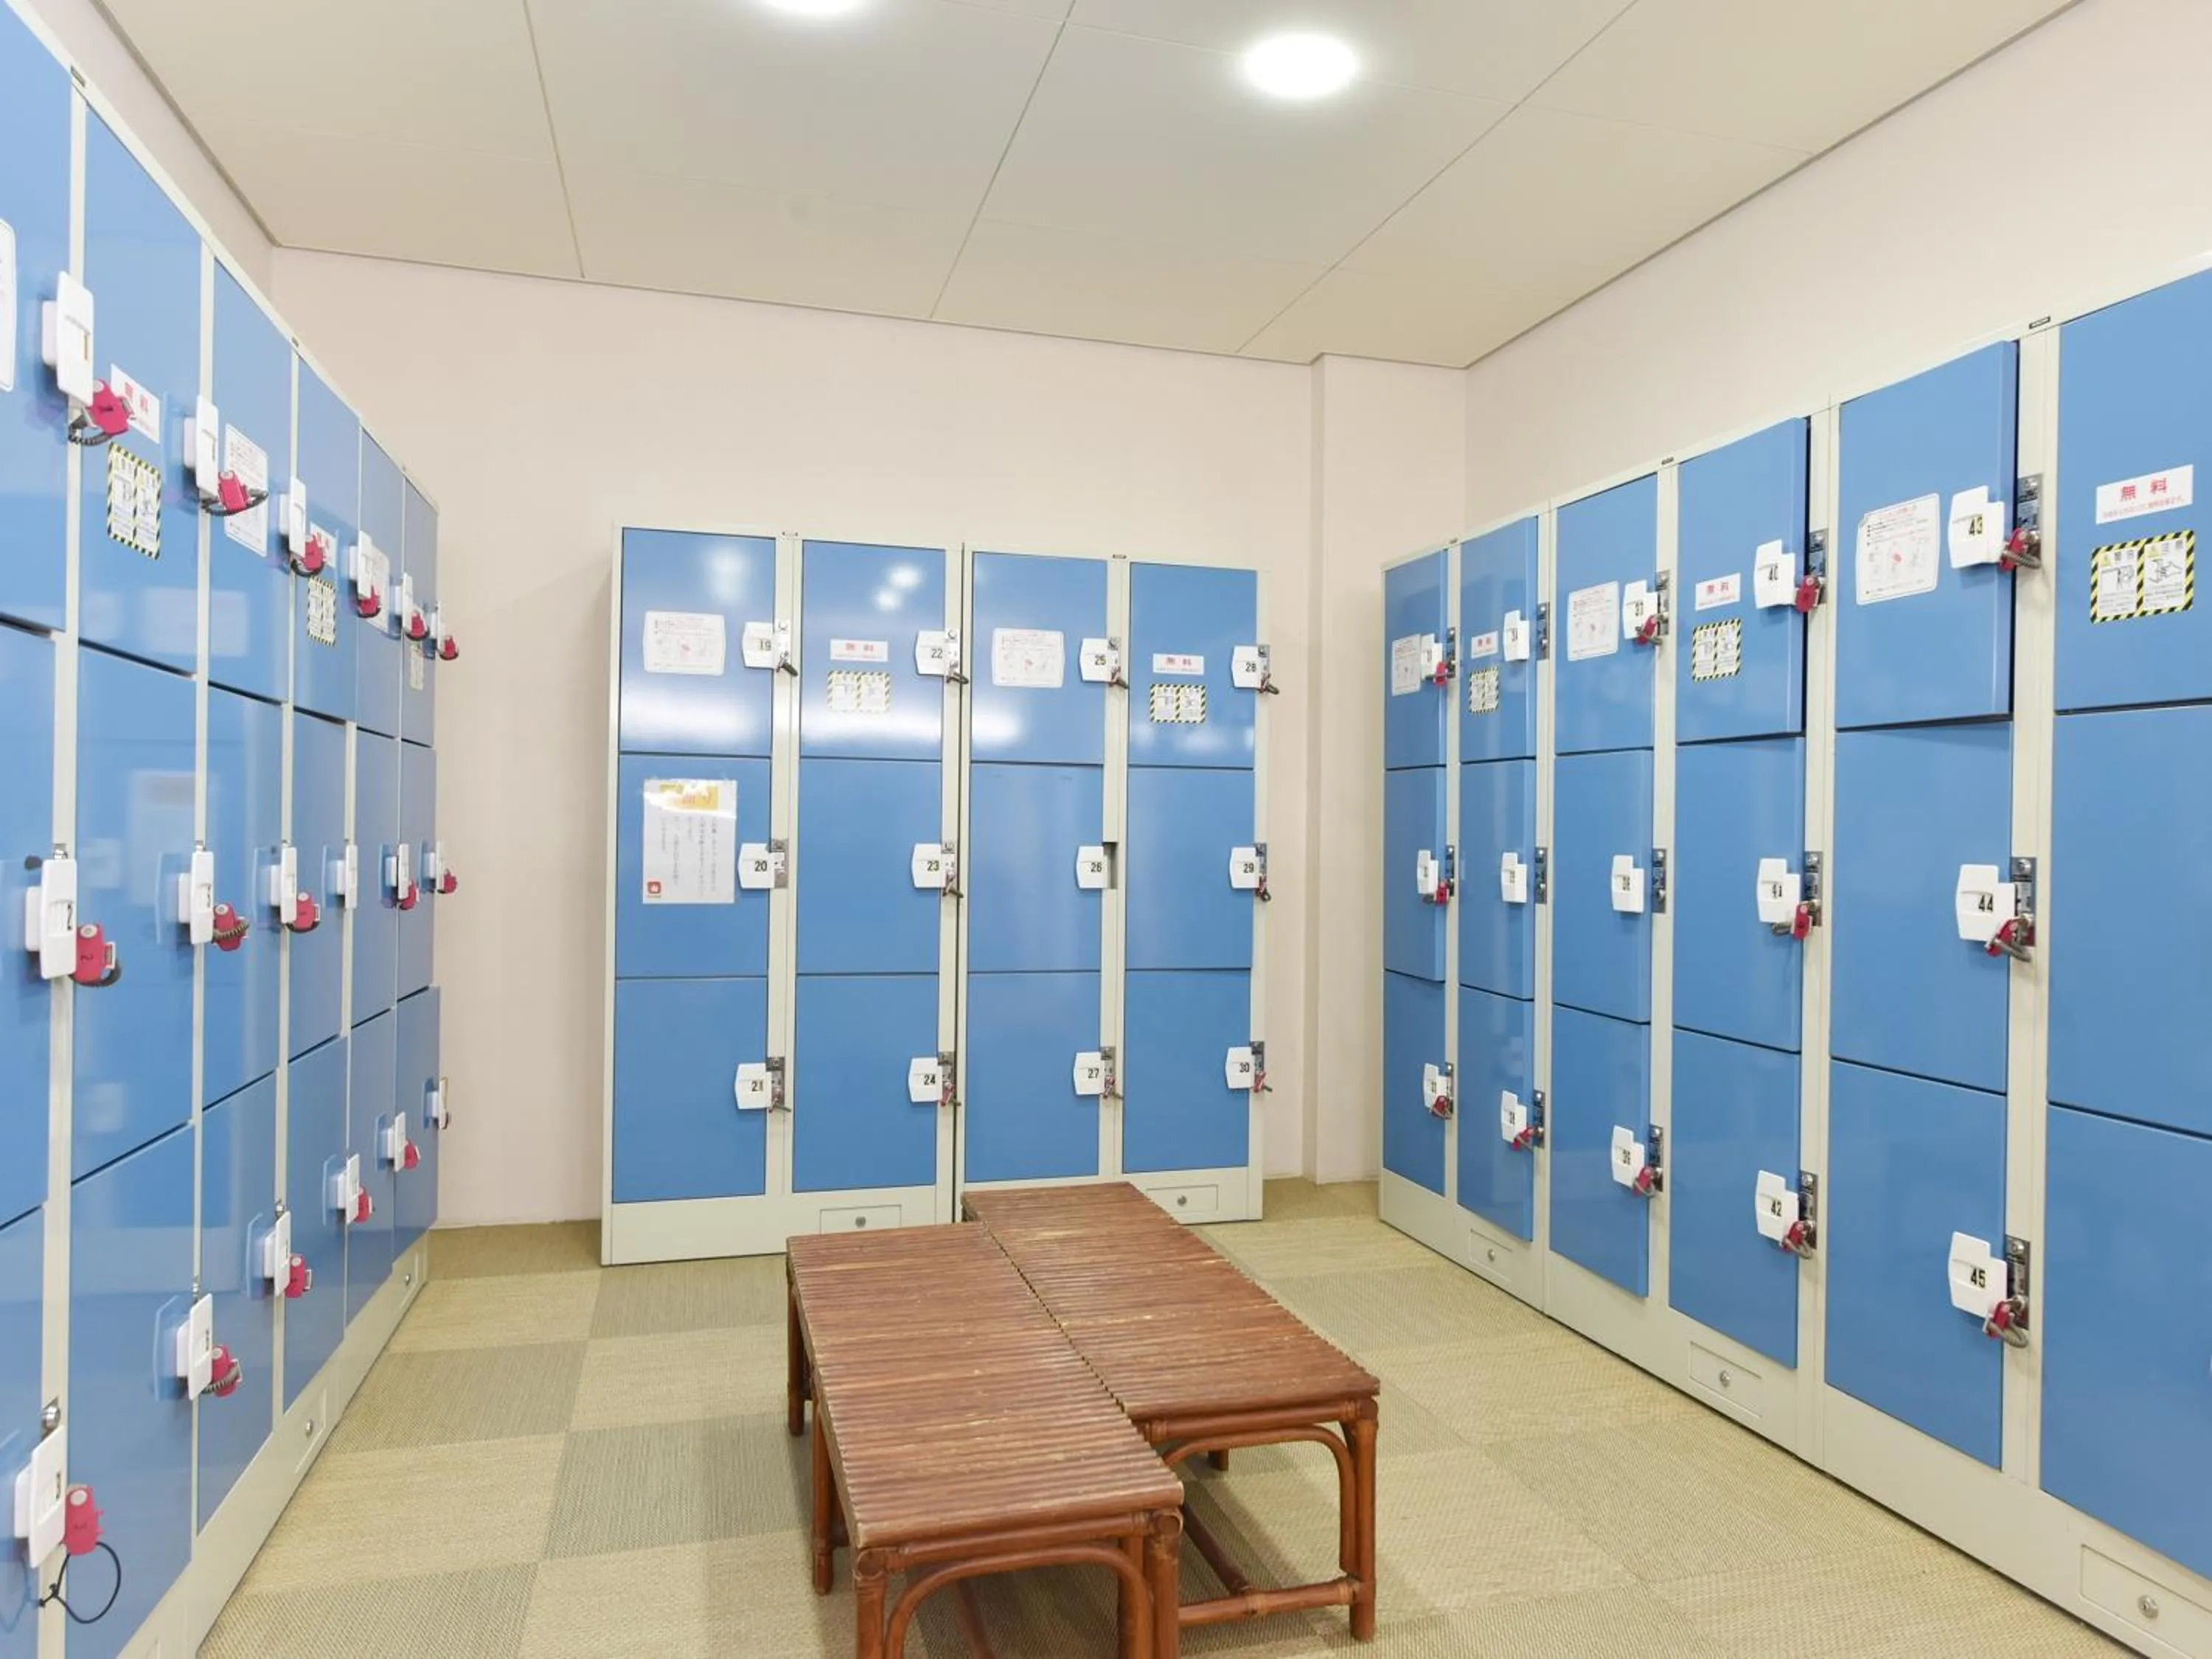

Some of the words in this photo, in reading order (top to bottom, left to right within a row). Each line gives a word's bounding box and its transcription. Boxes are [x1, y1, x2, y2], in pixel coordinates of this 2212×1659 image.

[2121, 478, 2167, 501] 無料
[1969, 516, 1983, 536] 43
[759, 640, 771, 651] 19
[931, 649, 944, 659] 22
[1094, 655, 1106, 667] 25
[754, 860, 768, 872] 20
[927, 860, 940, 872] 23
[1243, 863, 1254, 874] 29
[1978, 893, 1993, 913] 44
[1088, 1068, 1099, 1079] 27
[1239, 1062, 1250, 1073] 30
[924, 1074, 936, 1086] 24
[752, 1081, 763, 1093] 21
[1771, 1201, 1783, 1217] 42
[1970, 1267, 1986, 1288] 45
